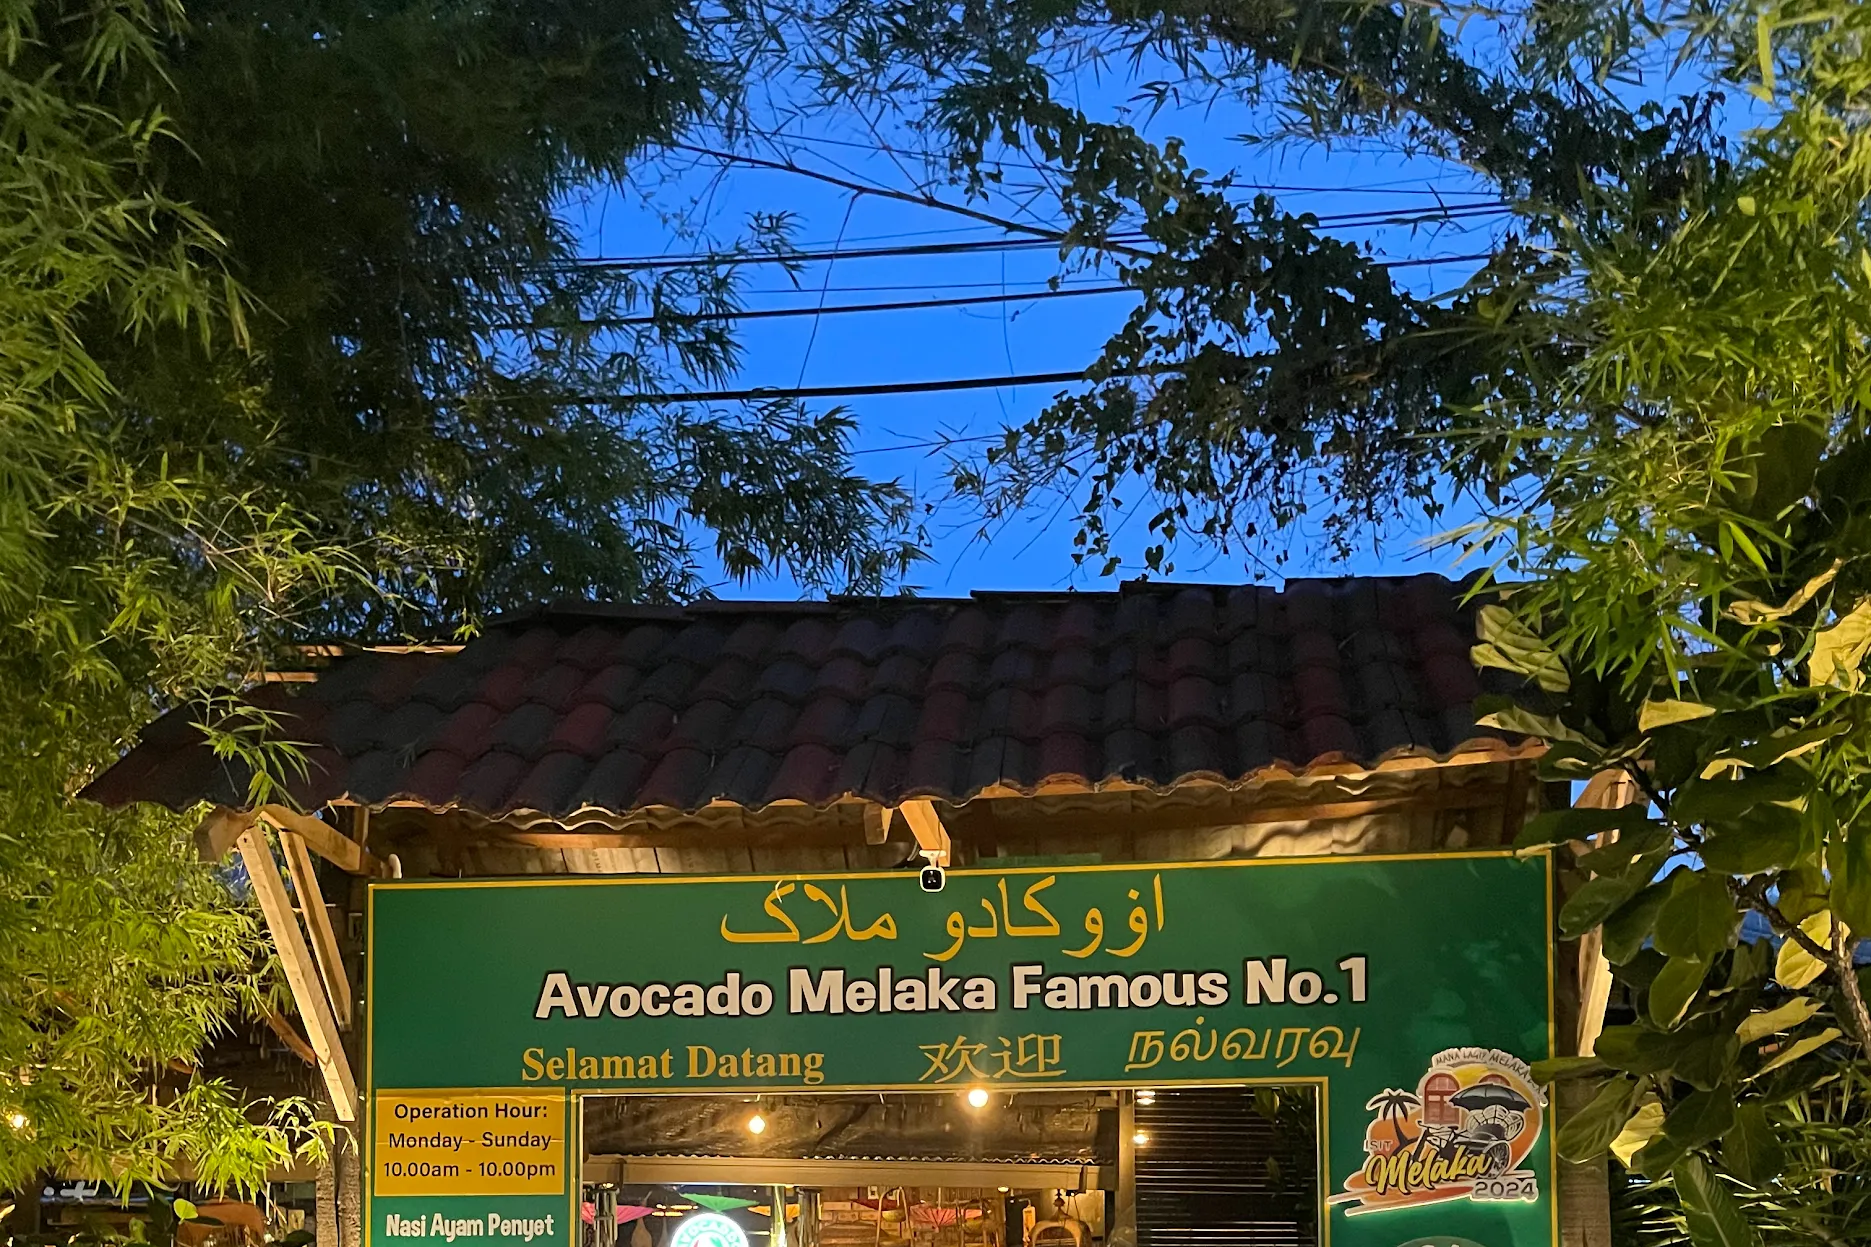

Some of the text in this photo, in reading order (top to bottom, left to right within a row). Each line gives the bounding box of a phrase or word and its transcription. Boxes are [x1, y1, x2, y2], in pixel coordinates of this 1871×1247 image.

[535, 956, 1369, 1019] Avocado Melaka Famous No.1
[919, 1032, 1067, 1083] 欢迎
[1125, 1015, 1362, 1072] நல்வரவு
[522, 1045, 825, 1084] Selamat Datang
[394, 1102, 548, 1124] Operation Hour:
[388, 1132, 463, 1152] Monday
[482, 1131, 552, 1151] Sunday
[383, 1162, 459, 1178] 10.00am
[478, 1161, 555, 1180] 10.00pm
[1365, 1145, 1493, 1195] Melaka
[1474, 1181, 1535, 1198] 2024
[386, 1213, 554, 1243] Nasi Ayam Penyet
